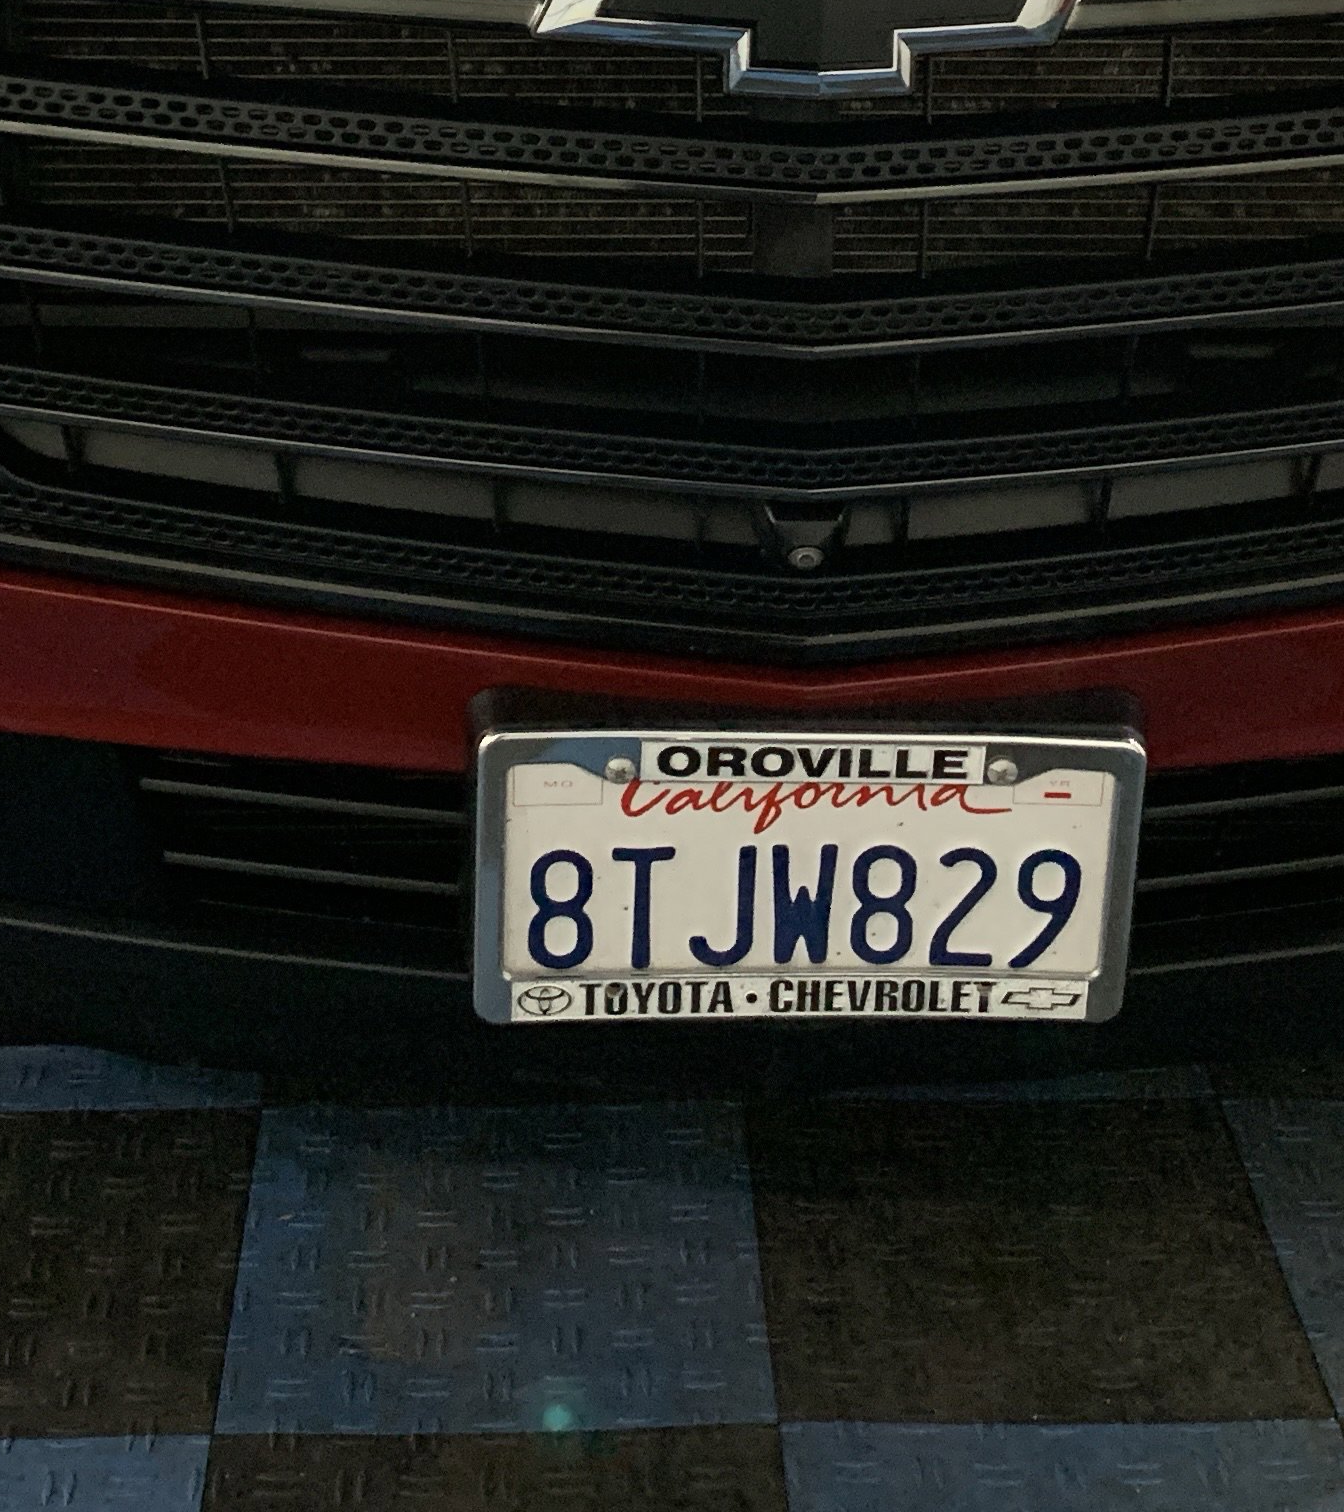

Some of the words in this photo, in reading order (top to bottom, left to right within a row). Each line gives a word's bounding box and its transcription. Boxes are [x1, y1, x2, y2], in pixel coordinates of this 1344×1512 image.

[657, 746, 968, 780] OROVILLE
[543, 779, 574, 789] MO
[1049, 779, 1072, 788] YR
[621, 779, 1012, 834] California
[528, 844, 1082, 969] 8TJW829
[584, 981, 733, 1016] TOYOTA
[769, 979, 996, 1014] CHEVROLET
